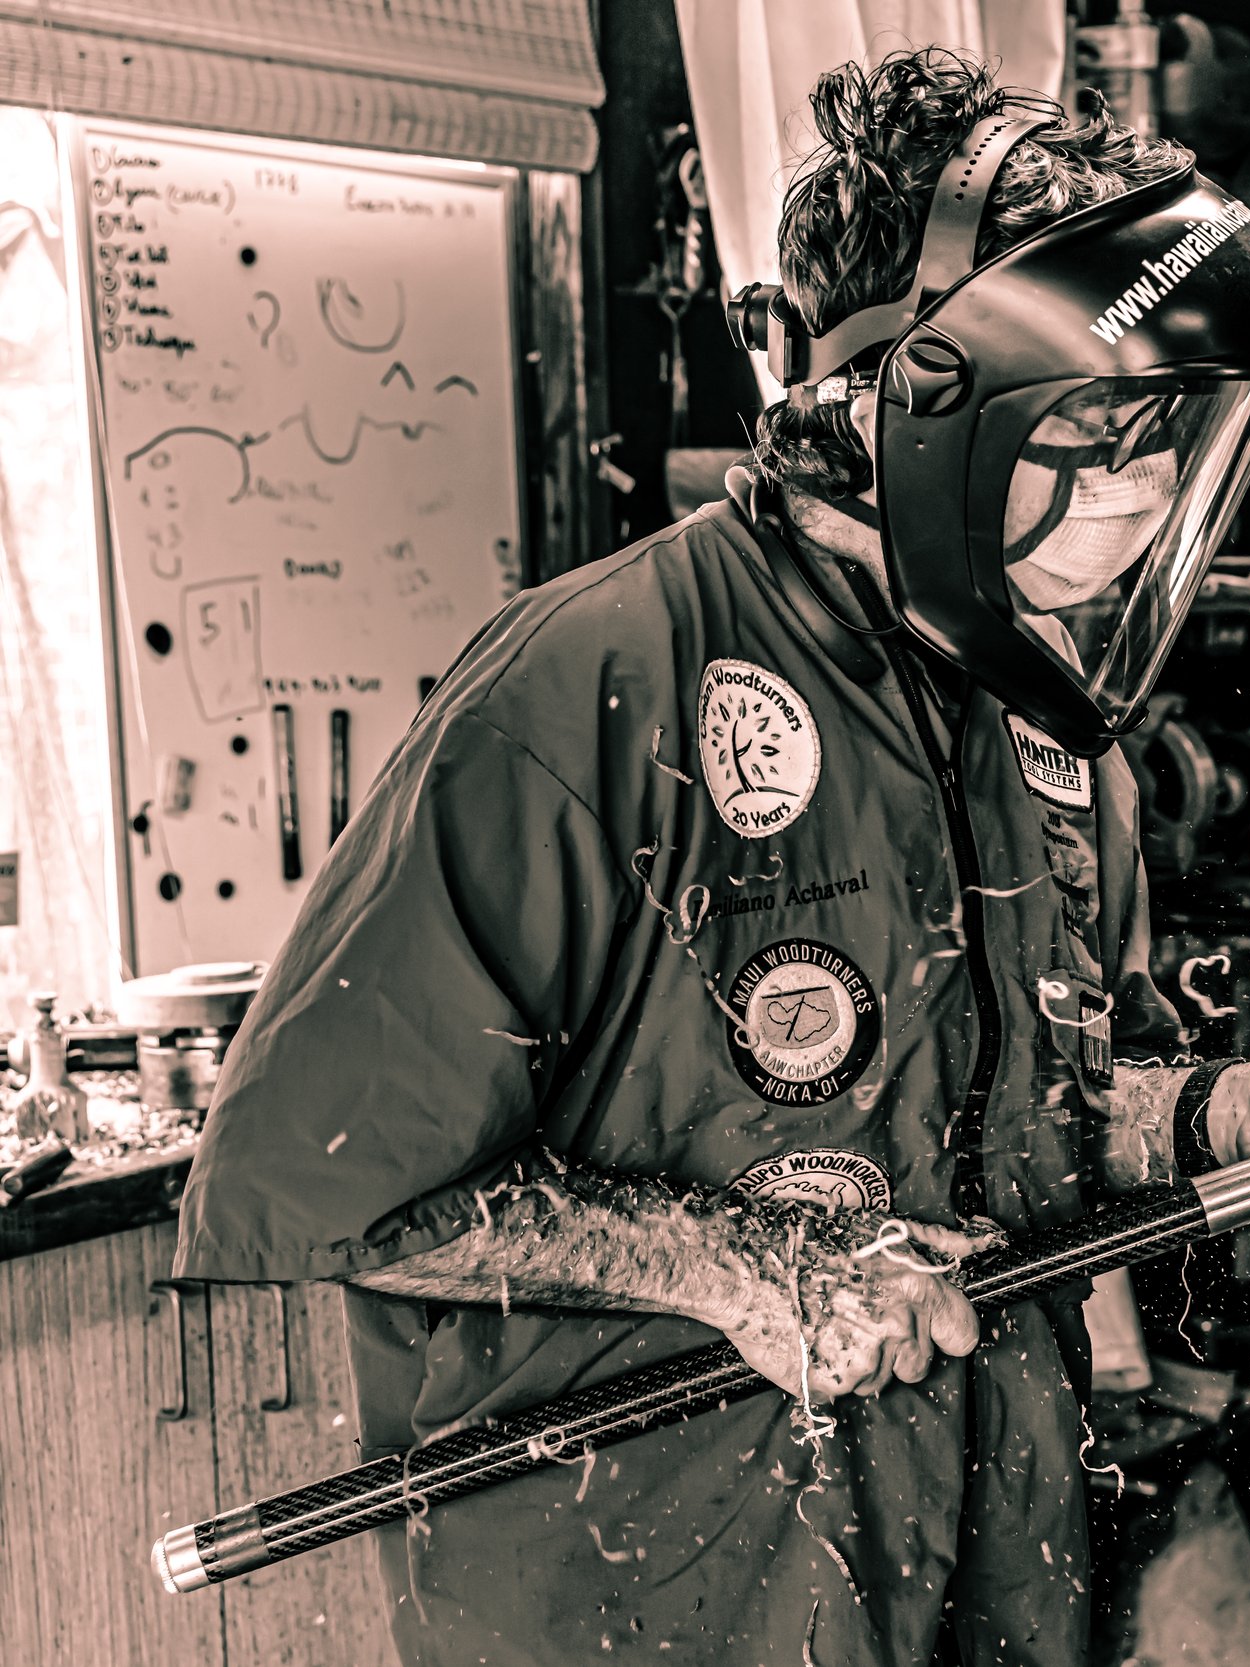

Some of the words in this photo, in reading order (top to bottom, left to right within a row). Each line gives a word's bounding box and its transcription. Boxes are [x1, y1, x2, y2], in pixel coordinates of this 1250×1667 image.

[711, 667, 803, 732] Woodturners
[1042, 770, 1082, 789] SYSTEMS
[732, 806, 748, 826] 20
[750, 801, 791, 829] Years
[784, 869, 869, 907] Achaval
[733, 967, 766, 1007] MAUI
[762, 943, 873, 1014] WOODTURNERS
[789, 1155, 888, 1211] WOODWORKERS
